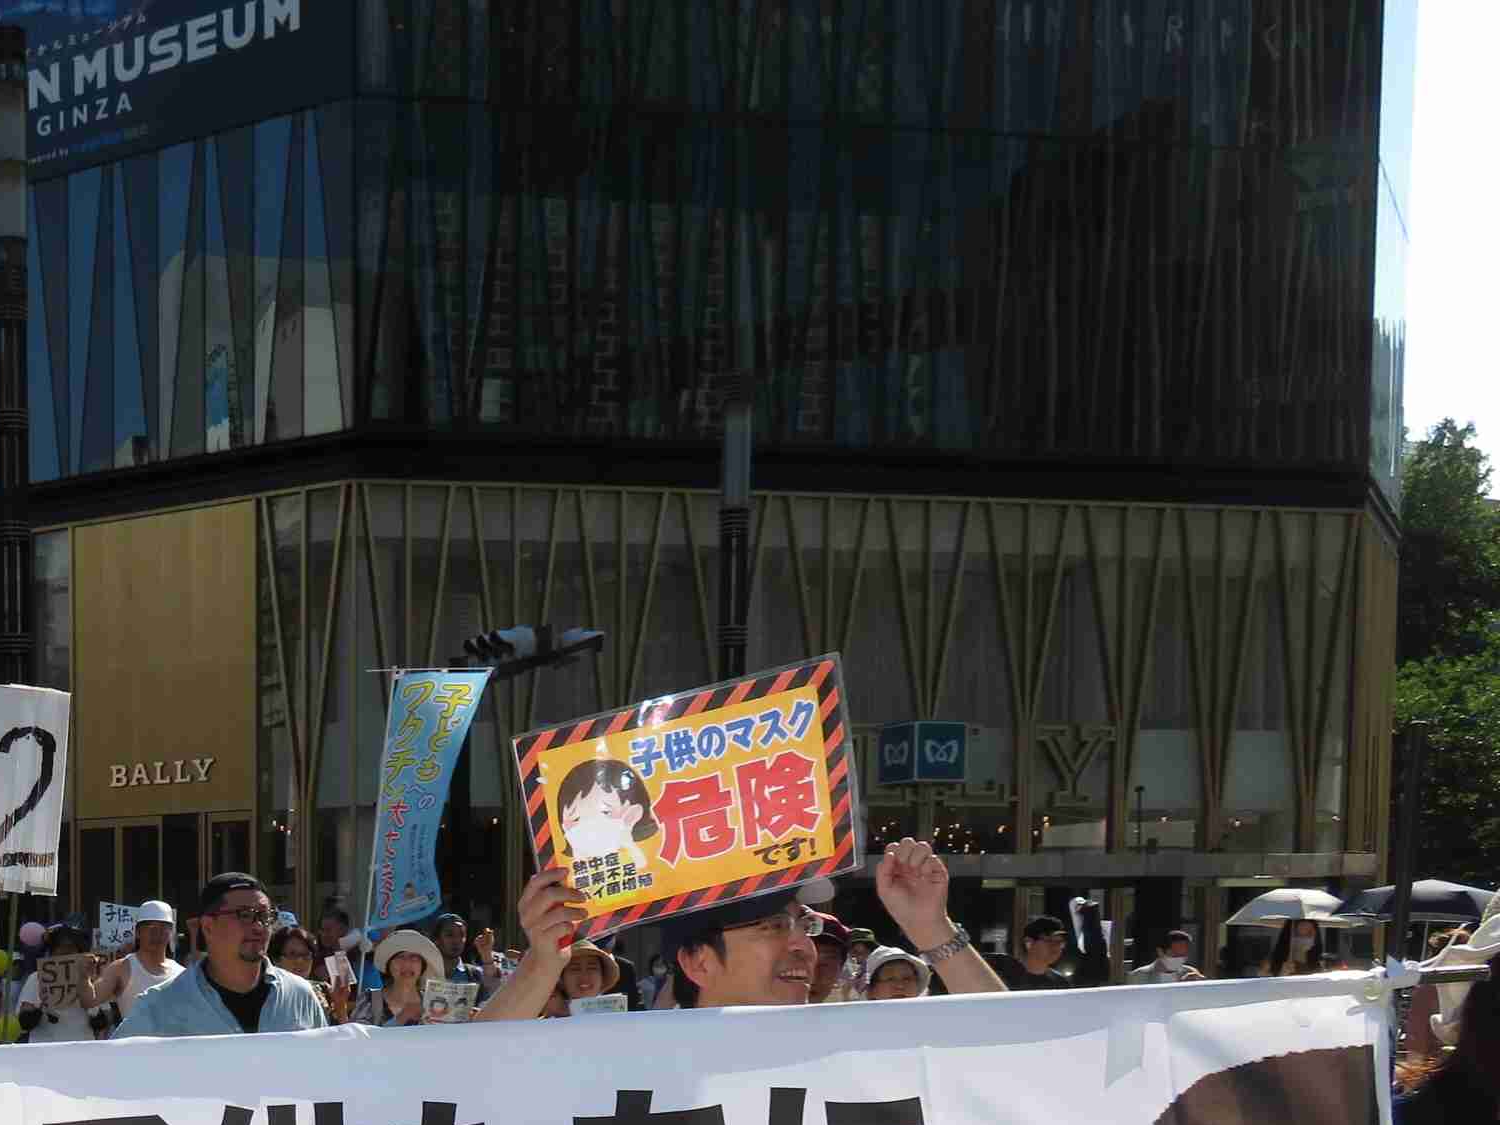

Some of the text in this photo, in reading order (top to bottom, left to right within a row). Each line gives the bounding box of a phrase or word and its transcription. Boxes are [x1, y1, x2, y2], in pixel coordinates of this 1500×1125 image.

[74, 0, 301, 97] MUSEUM
[36, 92, 133, 136] GINZA
[109, 758, 213, 787] BALLY
[629, 700, 816, 779] 子供のマスク
[650, 750, 824, 868] 危険
